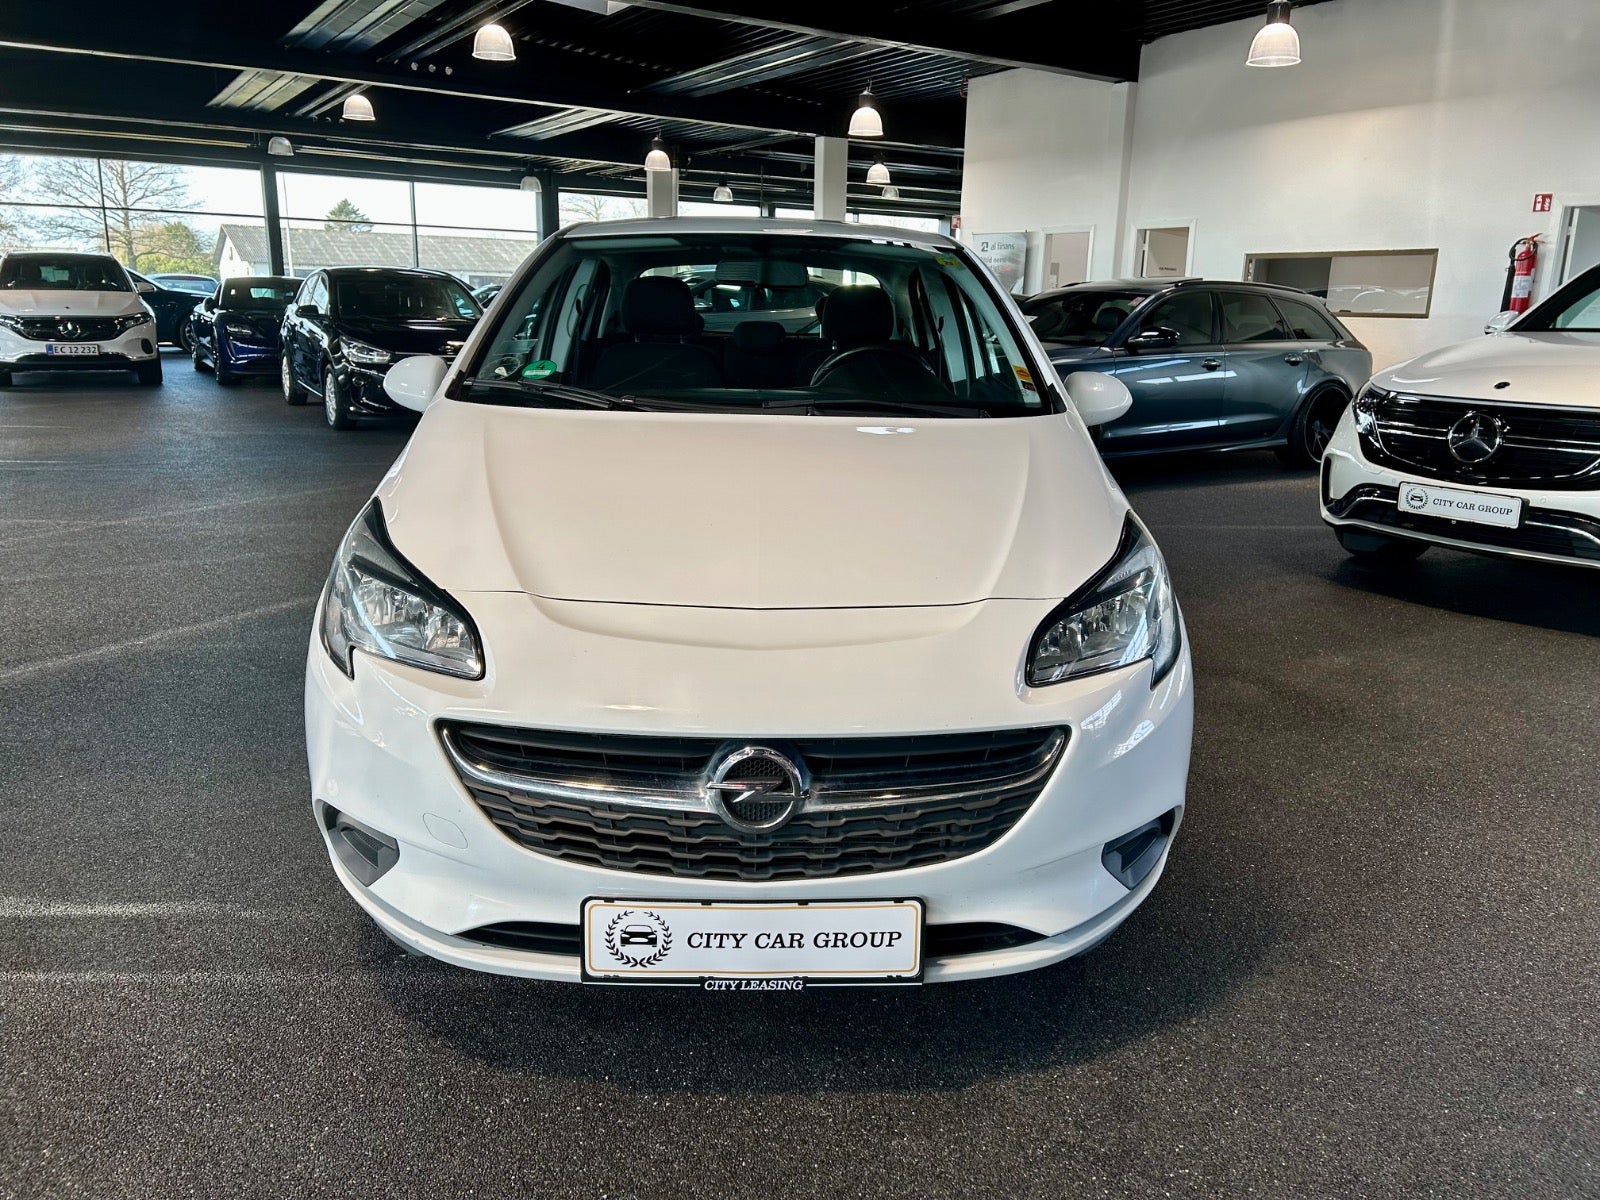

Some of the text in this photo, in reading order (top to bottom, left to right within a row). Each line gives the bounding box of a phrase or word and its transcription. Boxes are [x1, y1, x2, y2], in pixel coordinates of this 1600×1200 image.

[53, 346, 97, 354] EC 12 232
[1432, 498, 1513, 516] CITY CAR GROUP
[687, 931, 902, 949] CITY CAR GROUP
[704, 980, 804, 991] CITY LEASING
